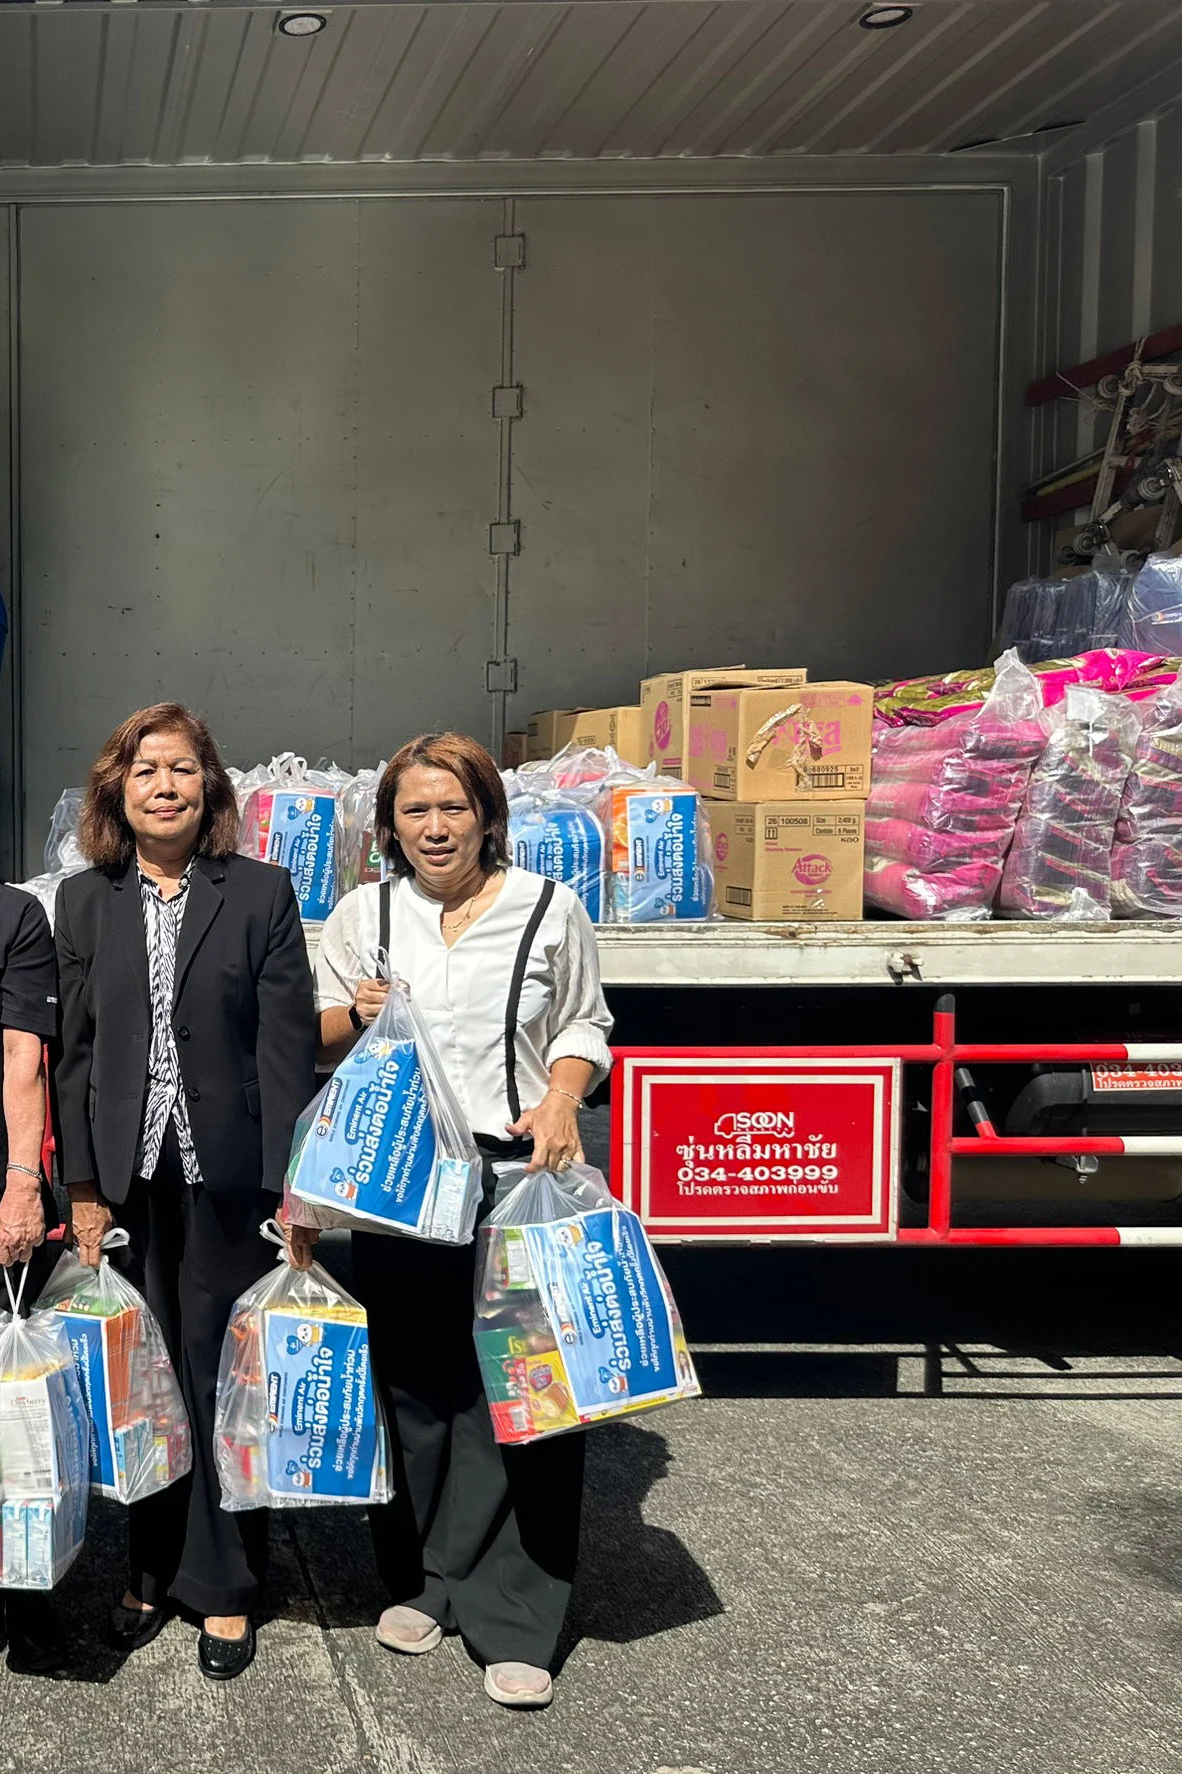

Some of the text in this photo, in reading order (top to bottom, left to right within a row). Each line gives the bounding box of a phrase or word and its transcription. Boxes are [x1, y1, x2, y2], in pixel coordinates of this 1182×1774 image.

[663, 813, 683, 902] ร่วมส่งต่อน้ำใจ
[791, 857, 832, 873] Attack
[346, 1090, 367, 1140] Eminent Air
[349, 1061, 400, 1184] ร่วมส่งต่อน้ำใจ
[678, 1166, 838, 1181] 034-403999
[678, 1179, 838, 1196] โปรดตรวจสภาพก่อนขับ
[584, 1241, 631, 1371] ร่วมส่งต่อน้ำใจ
[586, 1296, 601, 1334] Eminent
[295, 1382, 306, 1431] Eminent Air
[301, 1347, 333, 1468] ร่วมส่งต่อน้ำใจ
[332, 1349, 355, 1472] ช่วยเหลือผู้ประสบภัยน้ำท่วม
